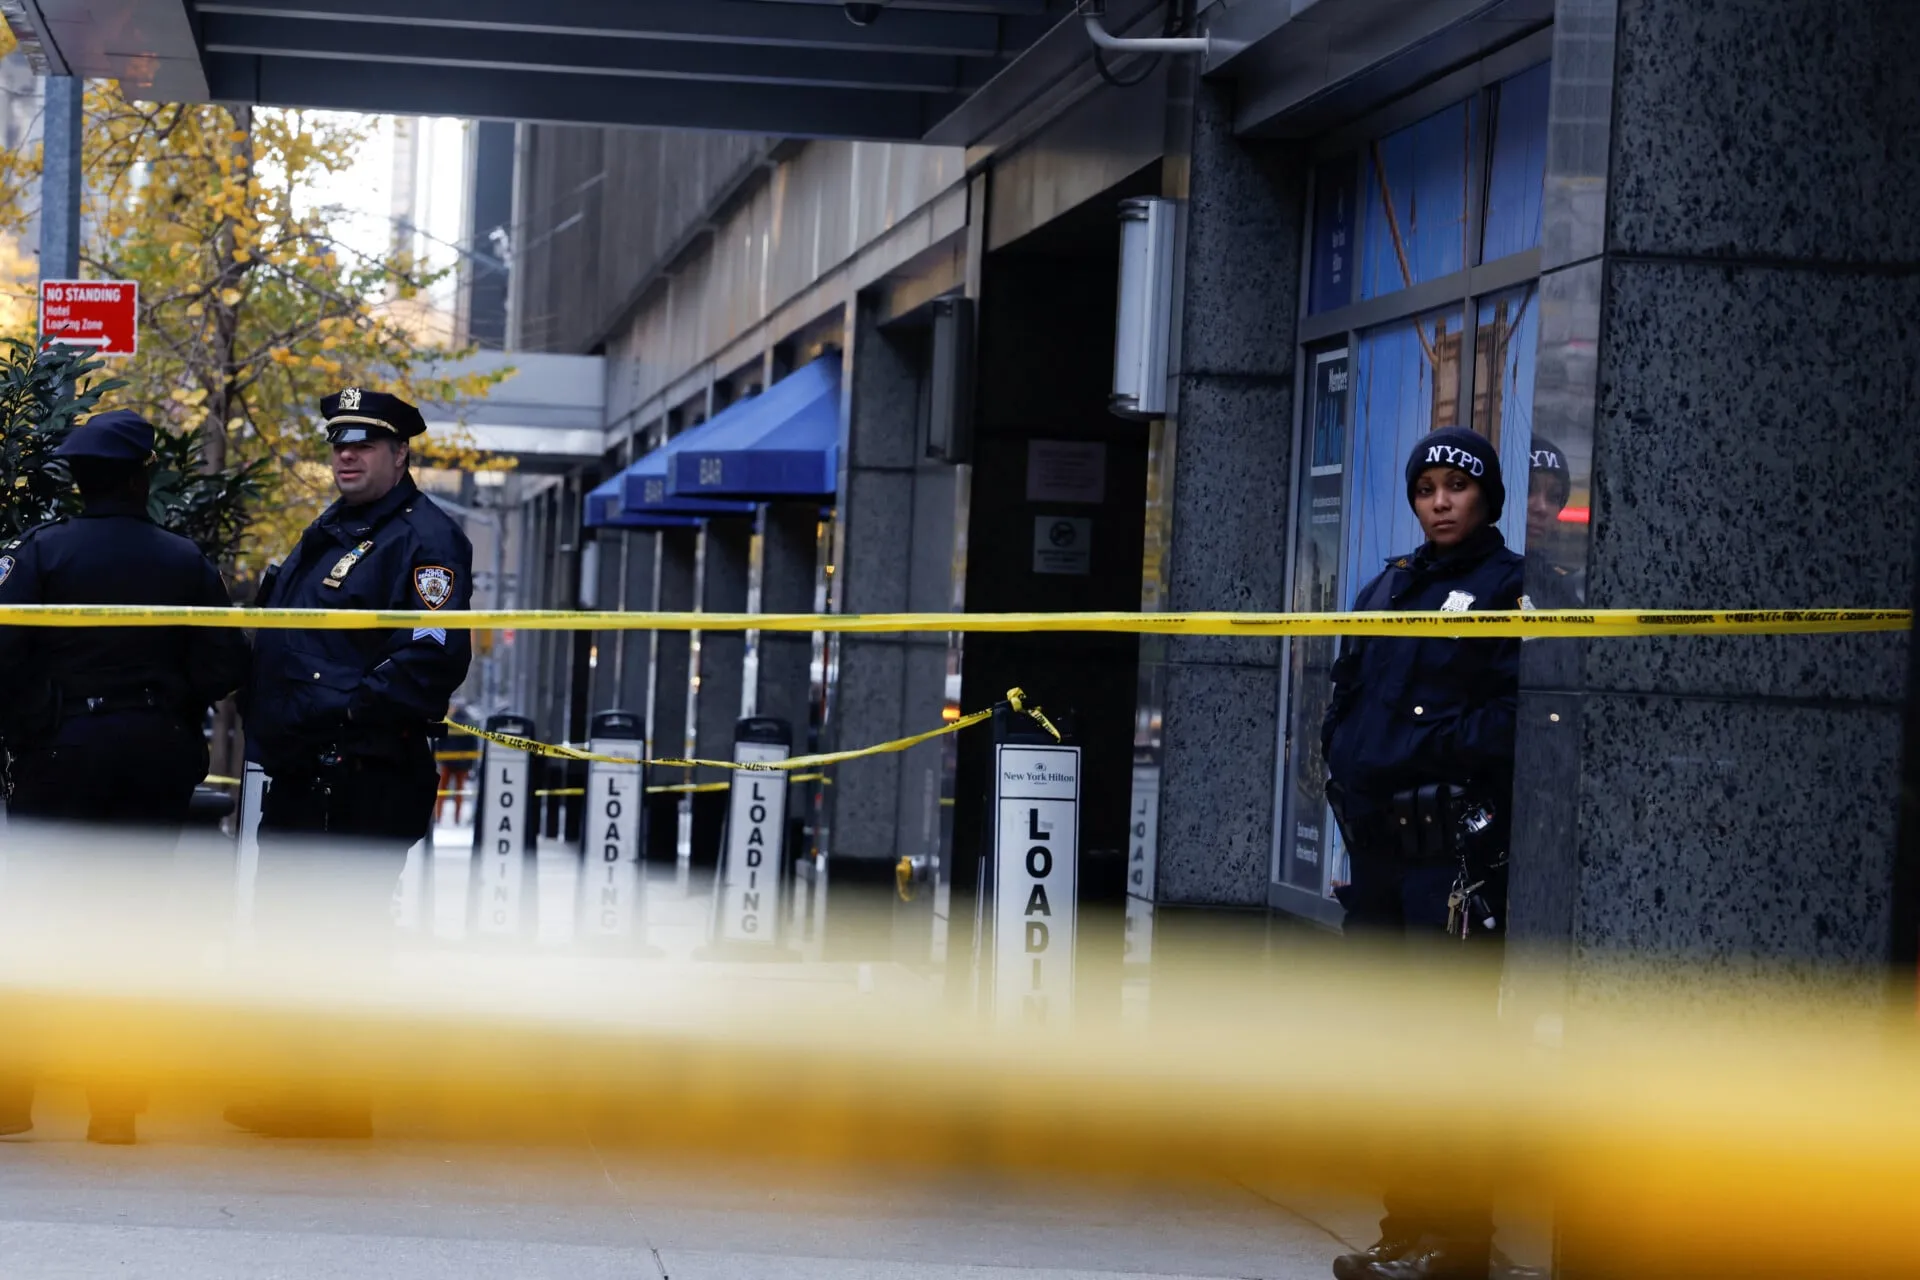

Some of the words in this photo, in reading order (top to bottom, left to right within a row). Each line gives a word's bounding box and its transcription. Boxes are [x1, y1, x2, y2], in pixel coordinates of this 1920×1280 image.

[47, 287, 64, 302] NO
[66, 287, 121, 303] STANDING
[46, 305, 70, 317] Hotel
[82, 318, 103, 331] Zone
[700, 458, 722, 485] BAR
[1425, 445, 1484, 477] NYPD
[1004, 771, 1024, 781] New
[1027, 772, 1047, 781] York
[1049, 773, 1074, 782] Hilton
[495, 767, 514, 926] LOADING
[600, 777, 622, 931] LOADING
[740, 782, 767, 935] LOADING
[1024, 808, 1052, 1026] LOADIN
